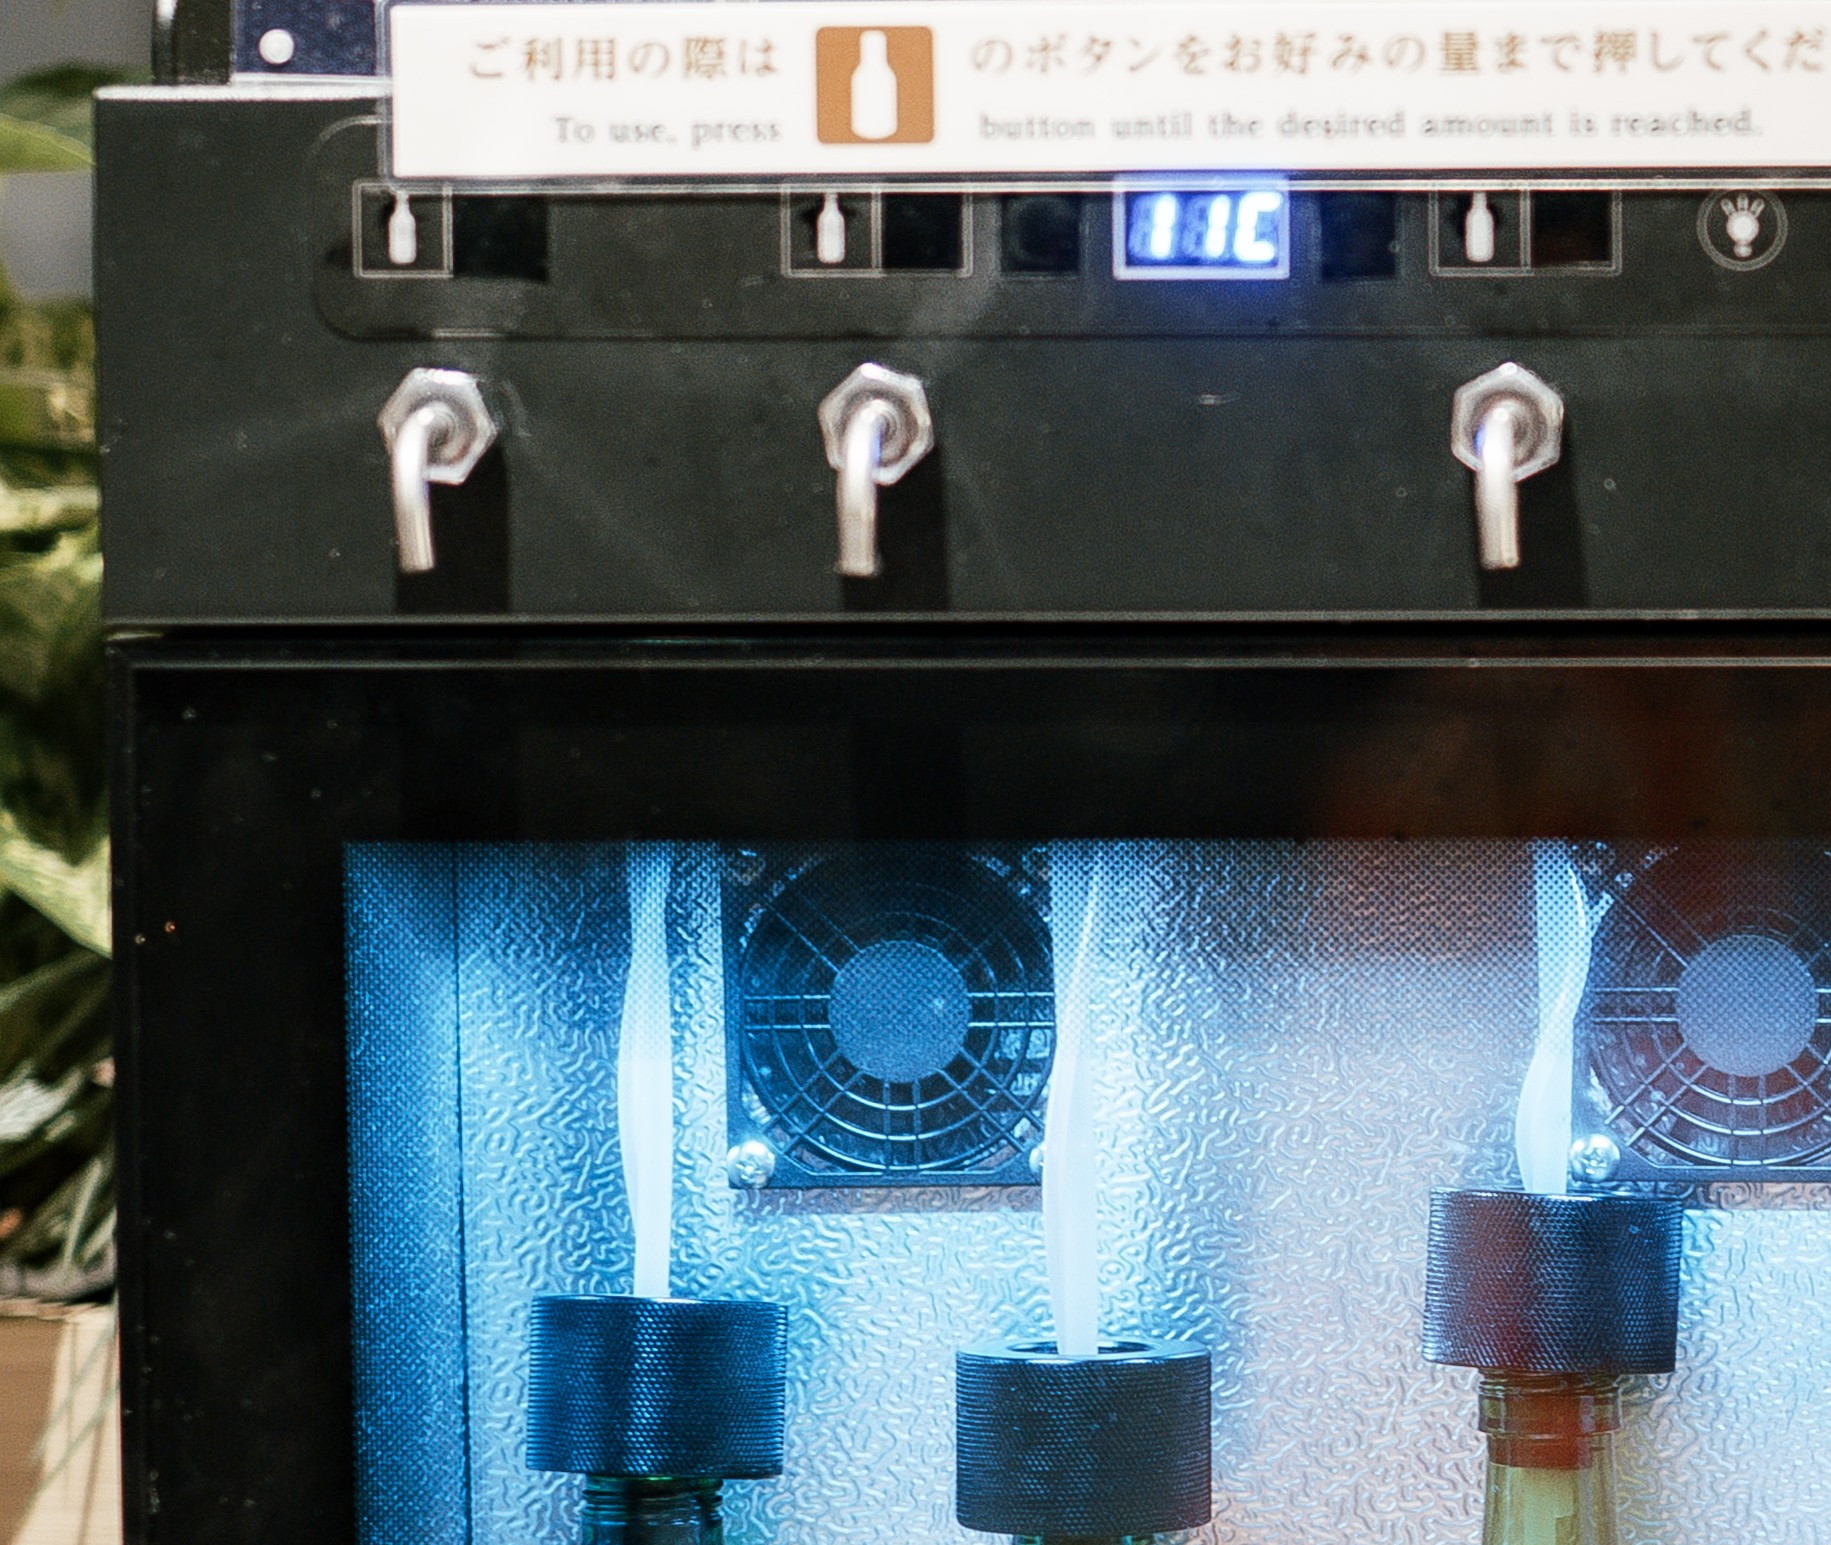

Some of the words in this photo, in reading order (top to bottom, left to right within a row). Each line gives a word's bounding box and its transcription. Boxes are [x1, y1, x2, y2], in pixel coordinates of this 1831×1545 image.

[469, 36, 778, 80] ご利用の際は
[556, 116, 595, 142] To
[692, 121, 782, 148] press
[979, 113, 1095, 139] button
[1111, 112, 1193, 138] until
[1208, 111, 1262, 138] the
[1276, 109, 1406, 141] desired
[1424, 111, 1553, 137] amount
[1569, 106, 1598, 136] is
[1609, 105, 1764, 137] reached.
